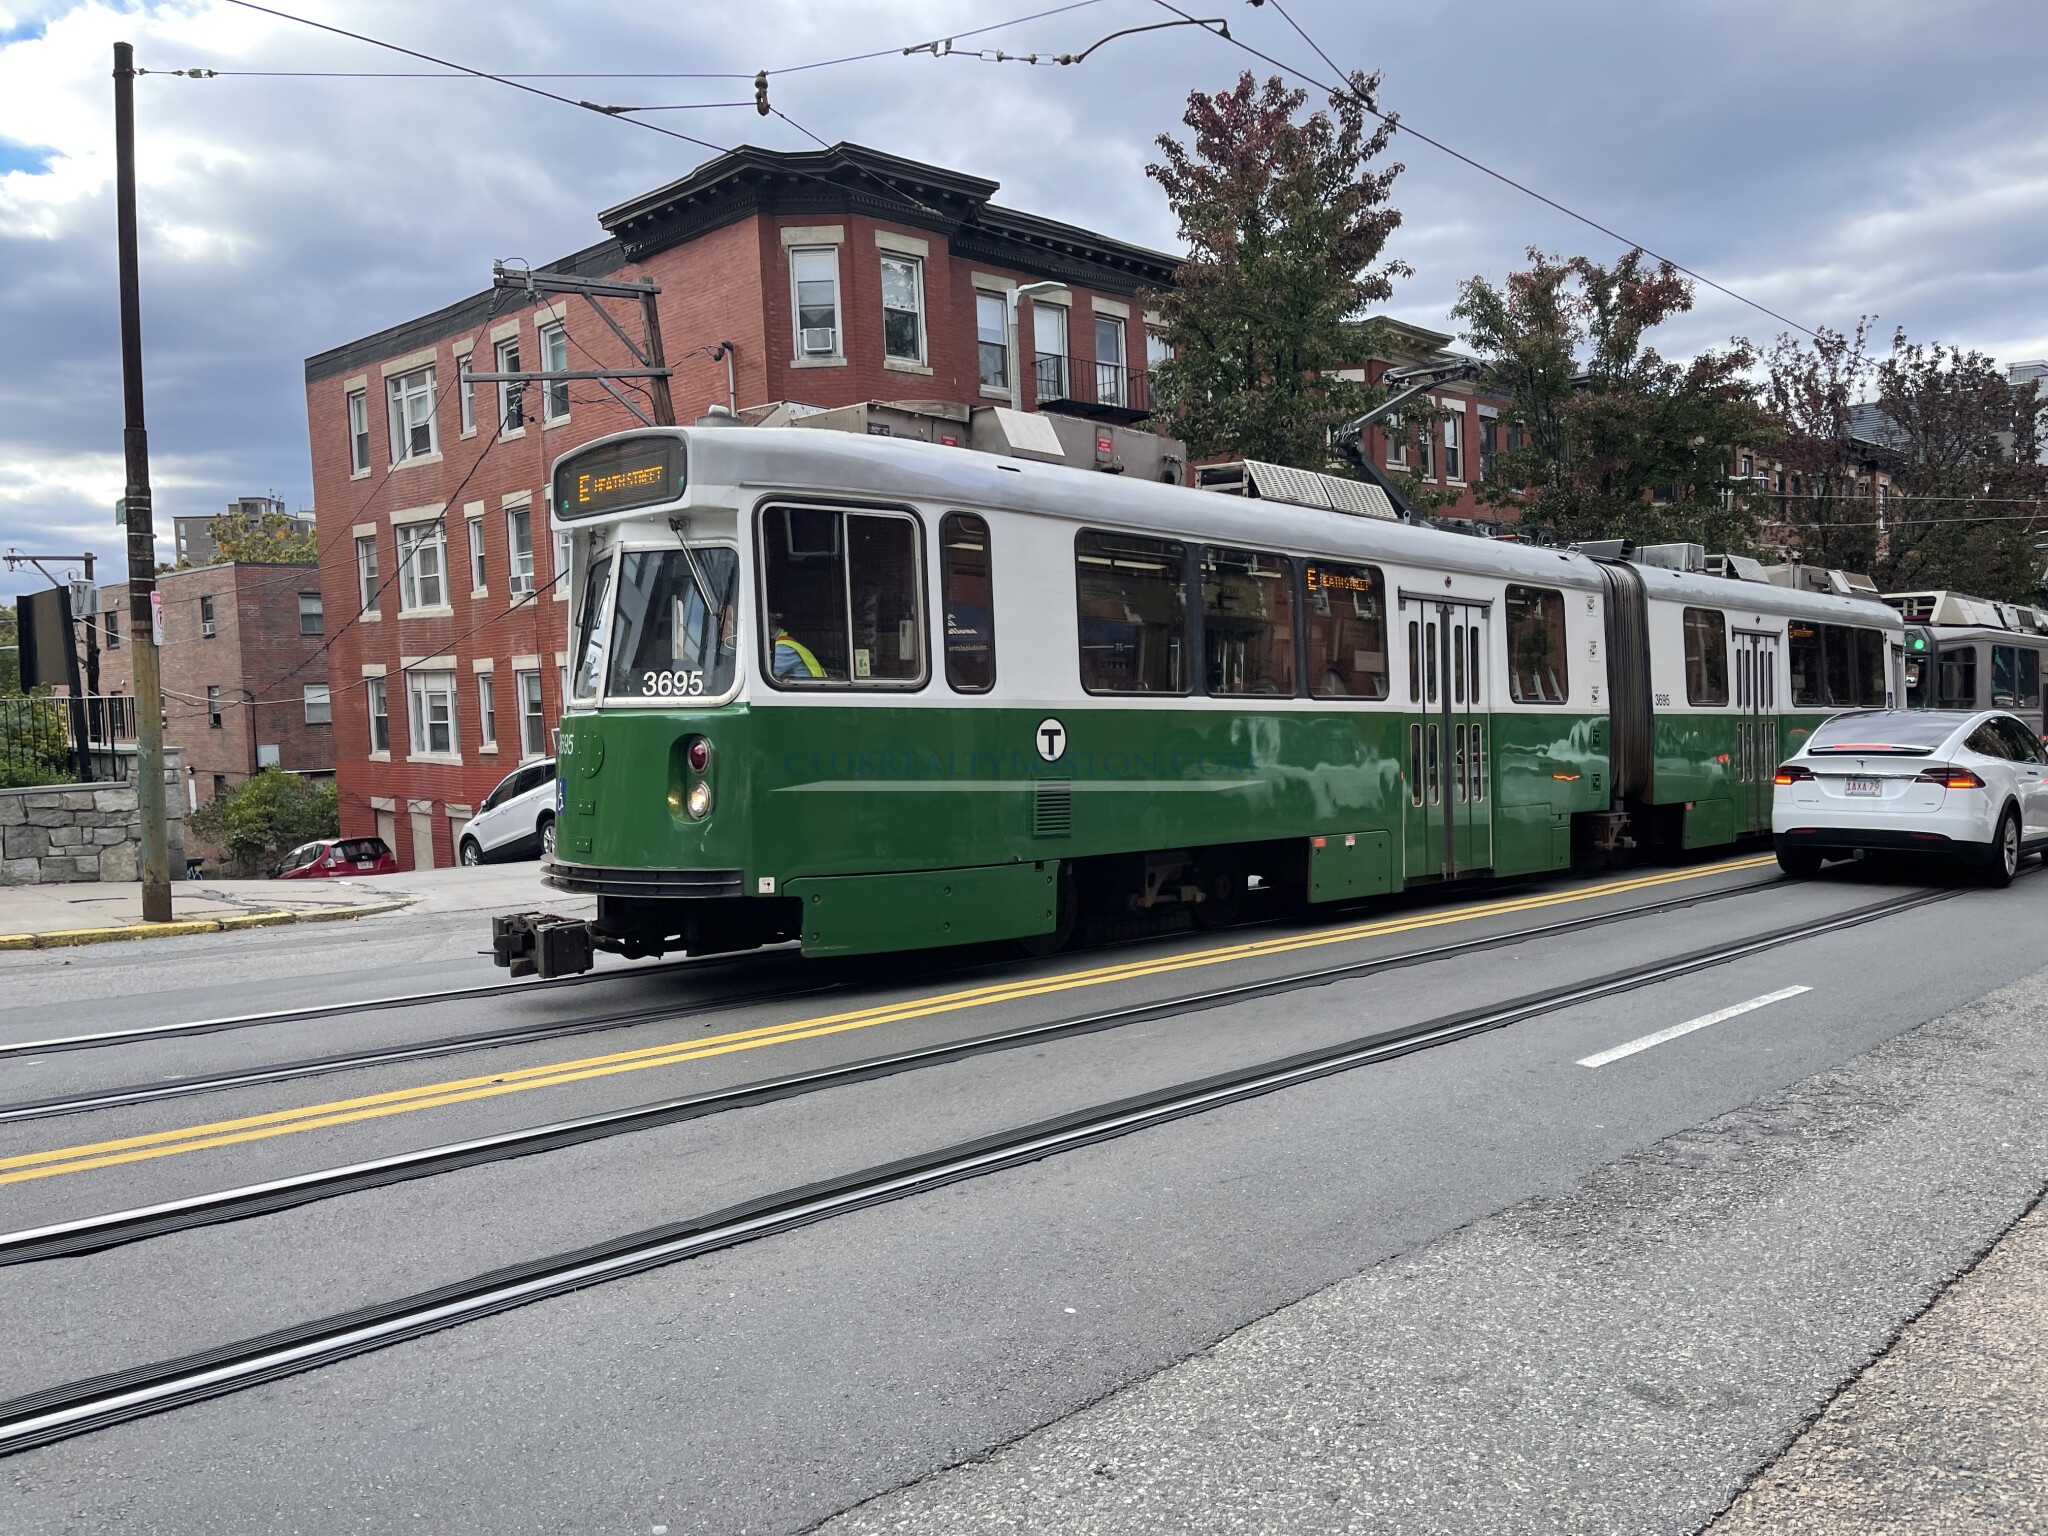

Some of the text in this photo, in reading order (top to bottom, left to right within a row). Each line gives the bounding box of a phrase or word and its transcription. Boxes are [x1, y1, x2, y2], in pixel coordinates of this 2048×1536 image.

[580, 475, 590, 502] E
[1307, 569, 1317, 591] E
[642, 670, 704, 696] 3695
[1040, 728, 1062, 755] T
